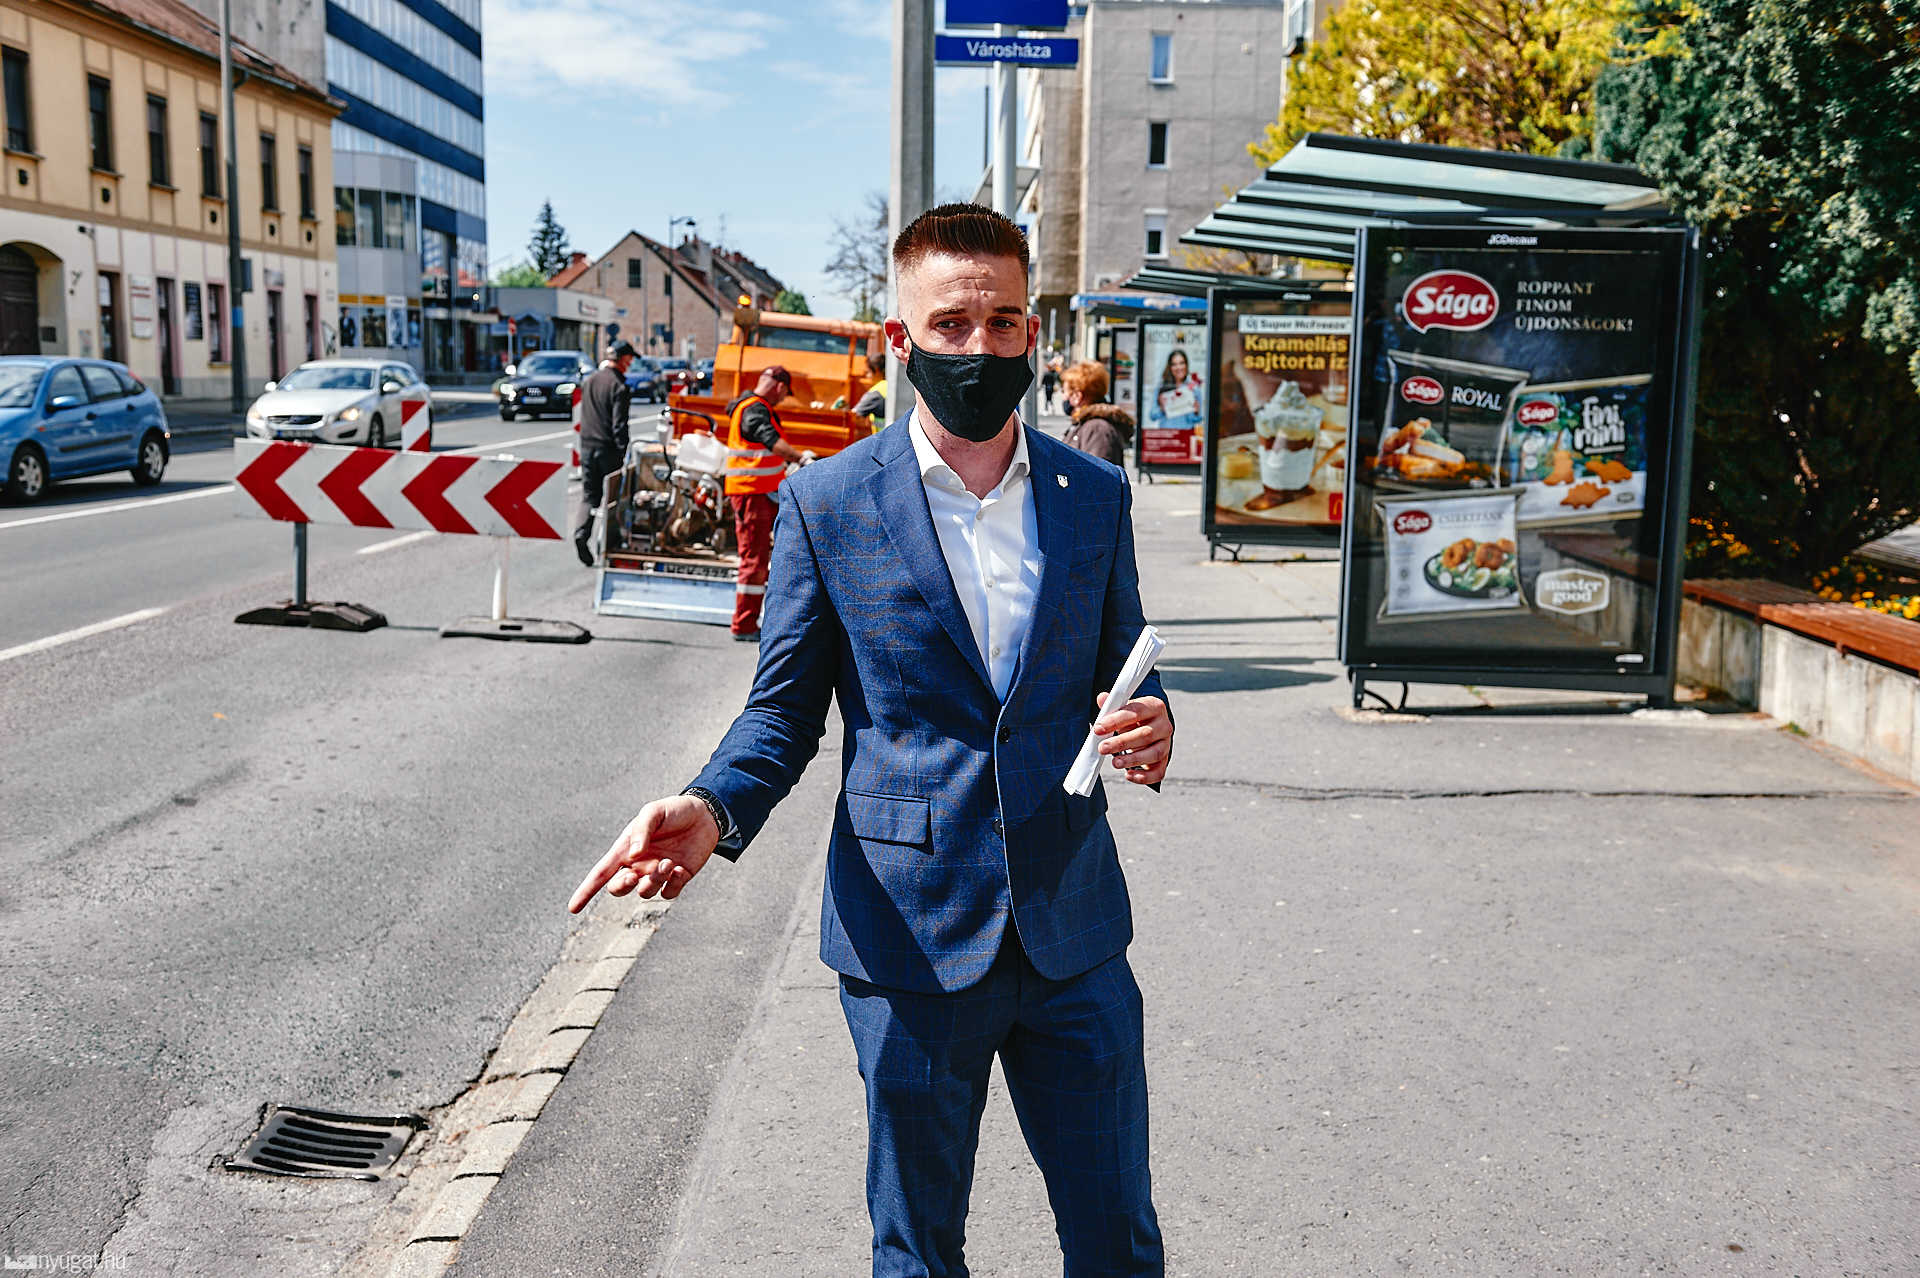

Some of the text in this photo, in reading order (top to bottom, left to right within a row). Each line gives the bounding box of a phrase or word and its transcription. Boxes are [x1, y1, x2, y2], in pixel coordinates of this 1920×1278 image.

[966, 41, 1052, 59] Városháza
[1516, 280, 1594, 295] ROPPANT
[1411, 285, 1489, 320] Sága
[1515, 299, 1573, 313] FINOM
[1260, 319, 1292, 331] Super
[1514, 316, 1633, 333] ÚJDONSÁGOK!
[1243, 334, 1348, 353] Karamellás
[1243, 352, 1326, 374] sajttorta
[1404, 381, 1440, 400] Sága
[1451, 386, 1503, 411] ROYAL
[1519, 405, 1556, 422] Sága
[1396, 514, 1430, 532] Sága
[1543, 579, 1603, 593] master
[1551, 590, 1593, 606] good
